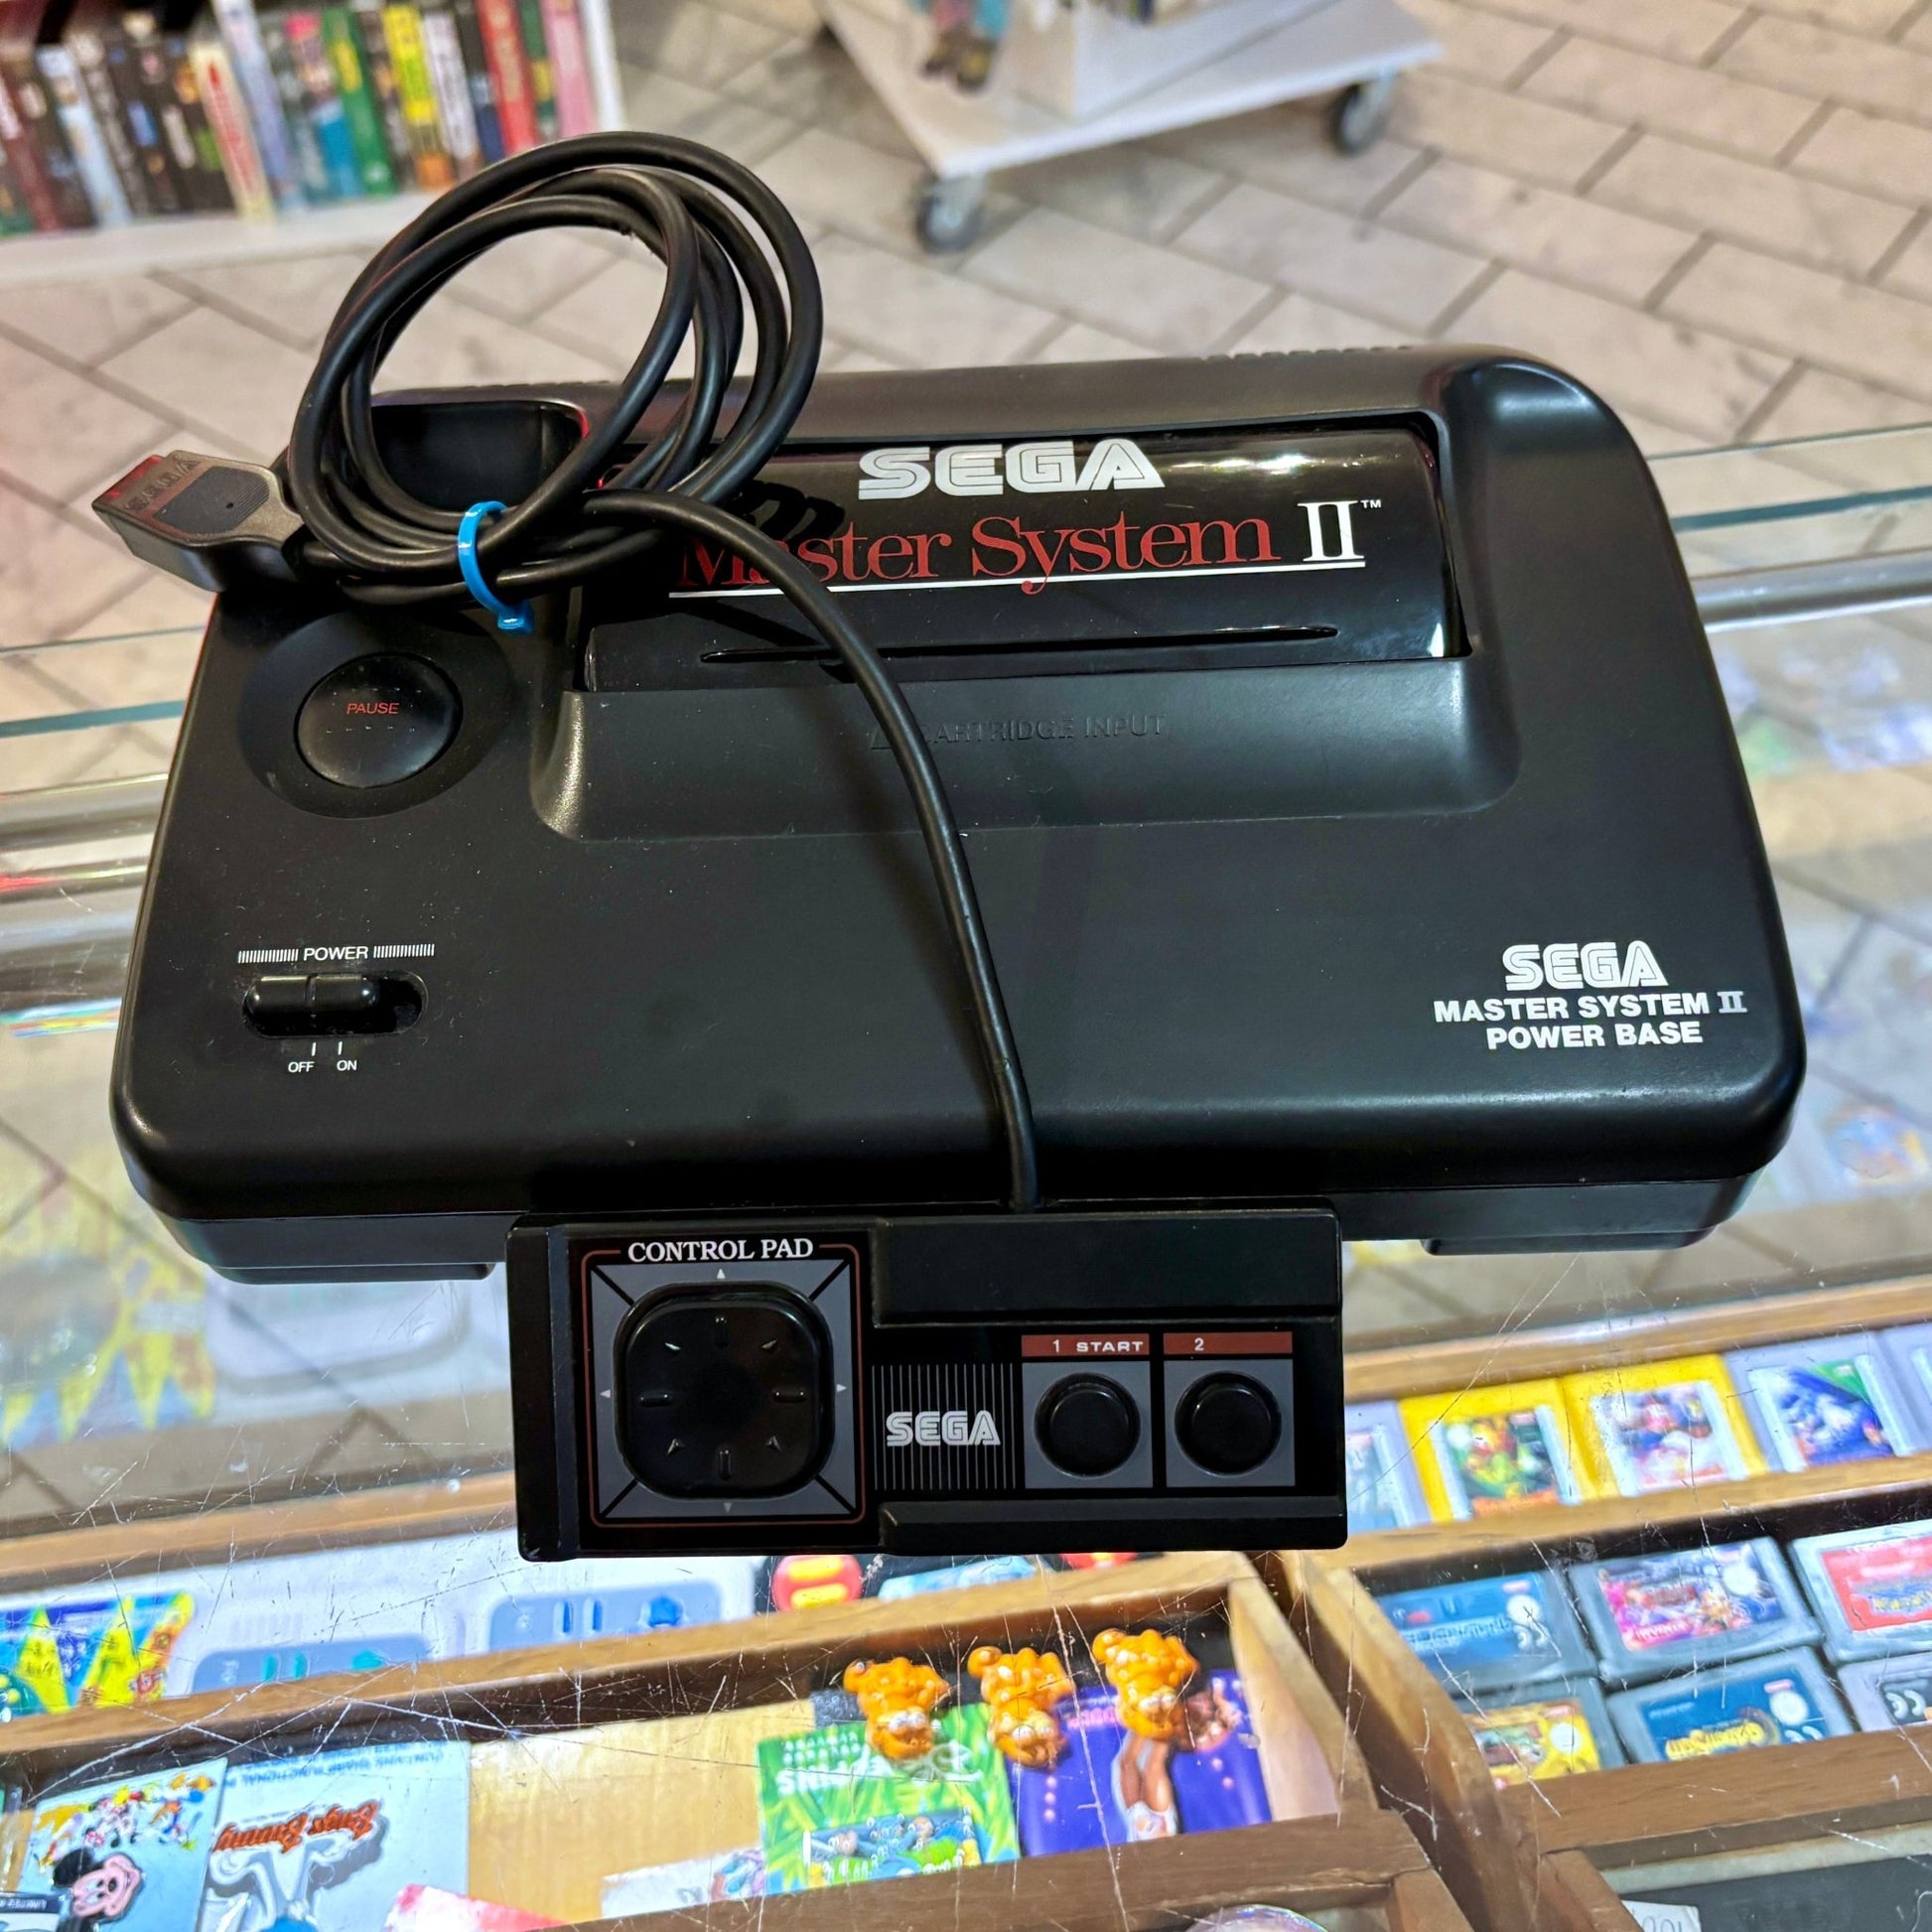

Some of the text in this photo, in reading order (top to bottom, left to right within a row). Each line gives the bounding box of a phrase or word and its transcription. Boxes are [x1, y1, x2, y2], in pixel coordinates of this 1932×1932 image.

[858, 439, 1166, 499] SEGA
[971, 510, 1282, 596] System
[1297, 499, 1365, 562] II
[346, 702, 399, 715] PAUSE
[1084, 713, 1165, 739] INPUT
[303, 945, 369, 962] POWER
[1502, 939, 1669, 992] SEGA
[1433, 990, 1748, 1023] MASTER SYSTEM II
[1485, 1020, 1704, 1050] POWER BASE
[287, 1060, 316, 1073] OFF
[336, 1059, 358, 1072] ON
[627, 1238, 814, 1264] CONTROL PAD
[1051, 1338, 1144, 1353] 1 START
[1193, 1337, 1205, 1352] 2
[886, 1410, 1001, 1447] SEGA
[211, 1812, 310, 1855] Bunny
